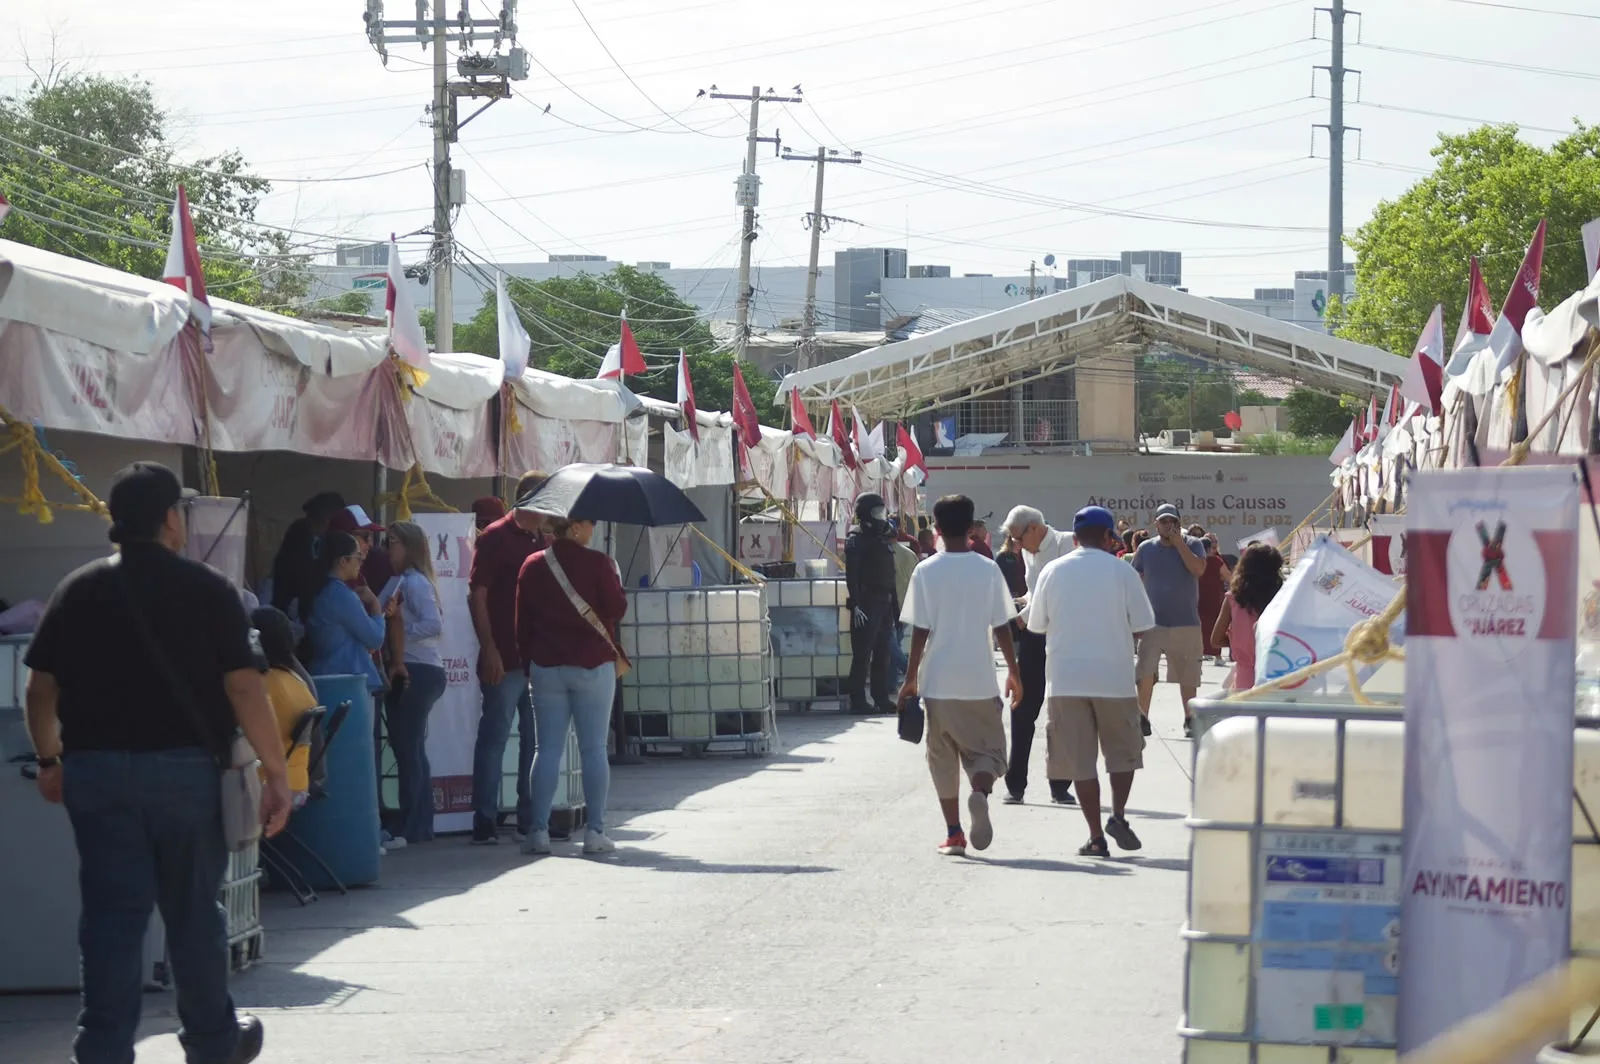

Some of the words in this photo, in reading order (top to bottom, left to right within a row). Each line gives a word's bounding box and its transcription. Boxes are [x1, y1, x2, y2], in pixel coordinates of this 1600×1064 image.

[1087, 494, 1167, 510] Atención
[1175, 499, 1184, 510] a
[1191, 494, 1215, 510] las
[1222, 494, 1287, 510] Causas
[1206, 513, 1235, 527] por
[1241, 510, 1257, 526] la
[1263, 513, 1293, 528] paz
[1412, 869, 1567, 909] AYUNTAMIENTO
